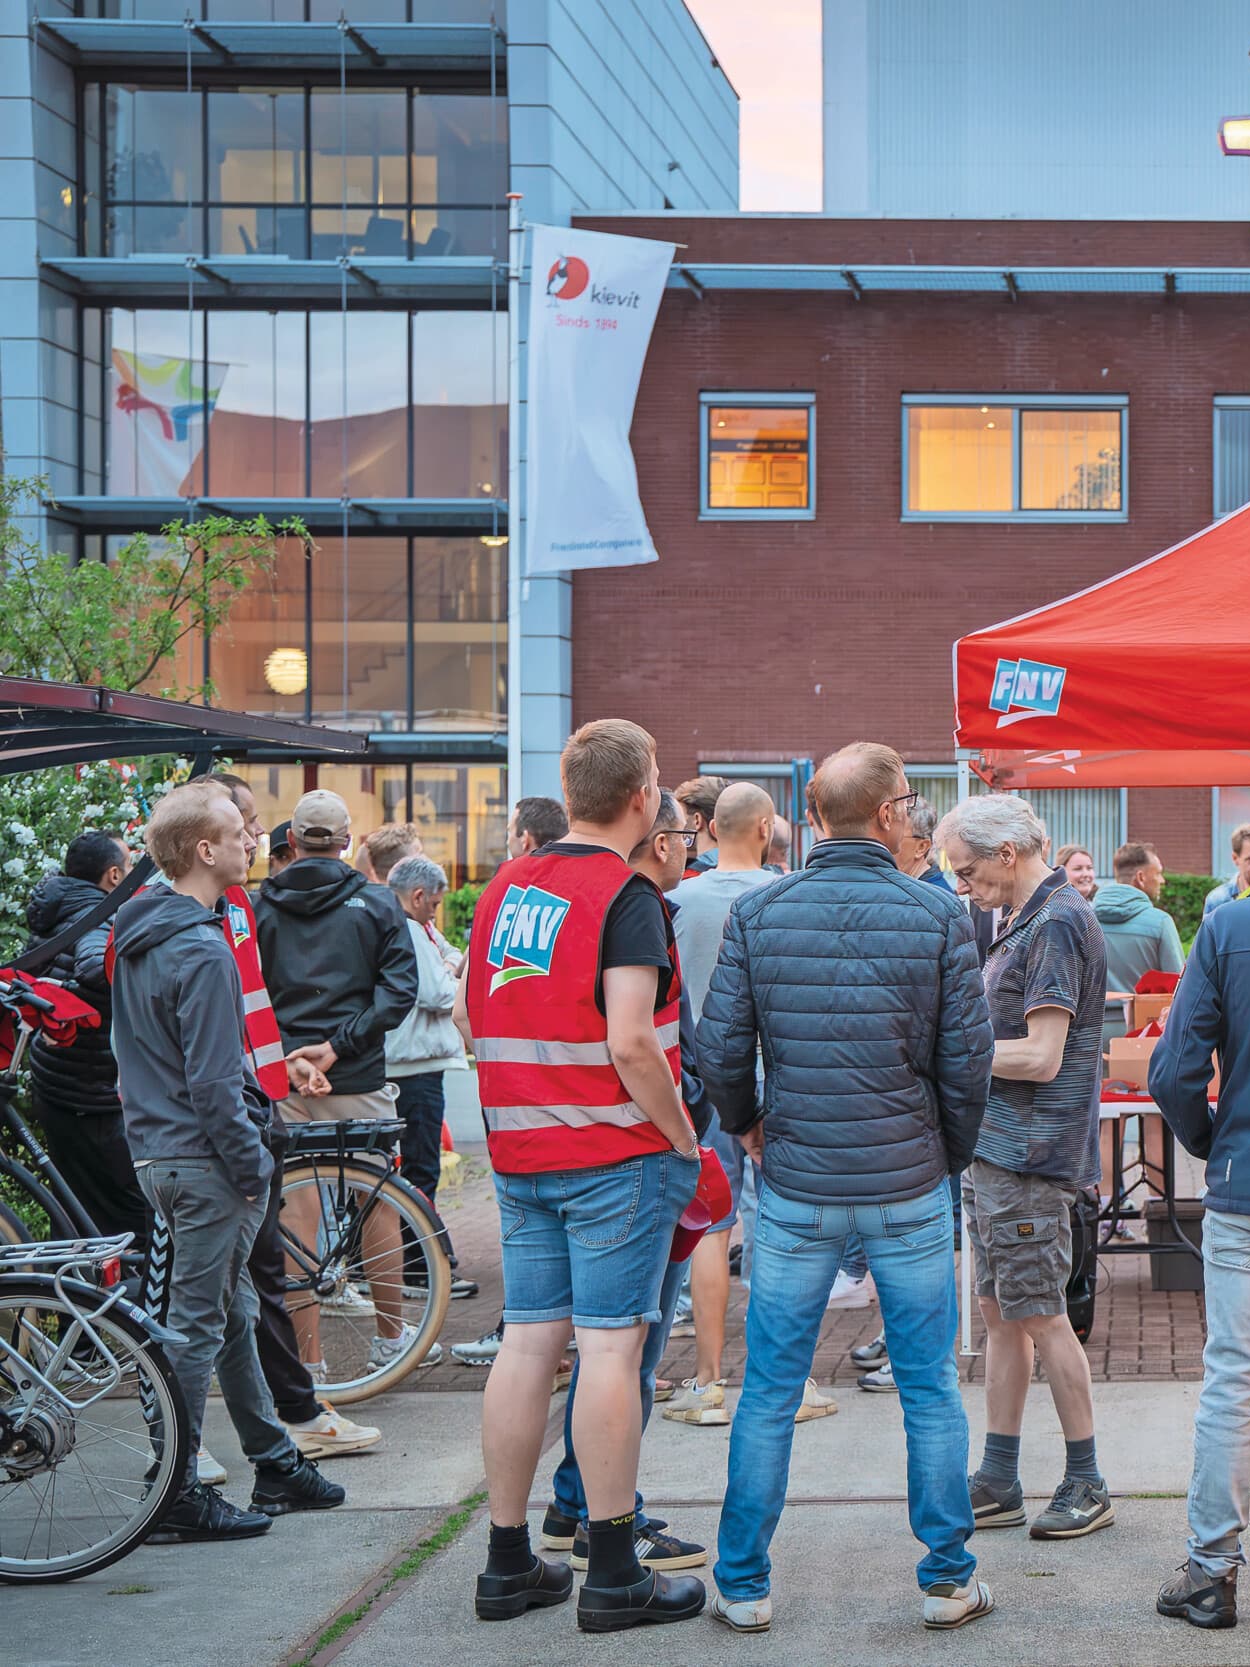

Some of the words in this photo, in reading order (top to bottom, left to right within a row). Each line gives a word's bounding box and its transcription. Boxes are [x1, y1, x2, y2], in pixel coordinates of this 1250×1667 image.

[591, 283, 640, 309] kievit
[994, 671, 1063, 701] FNV
[493, 903, 566, 951] FNV
